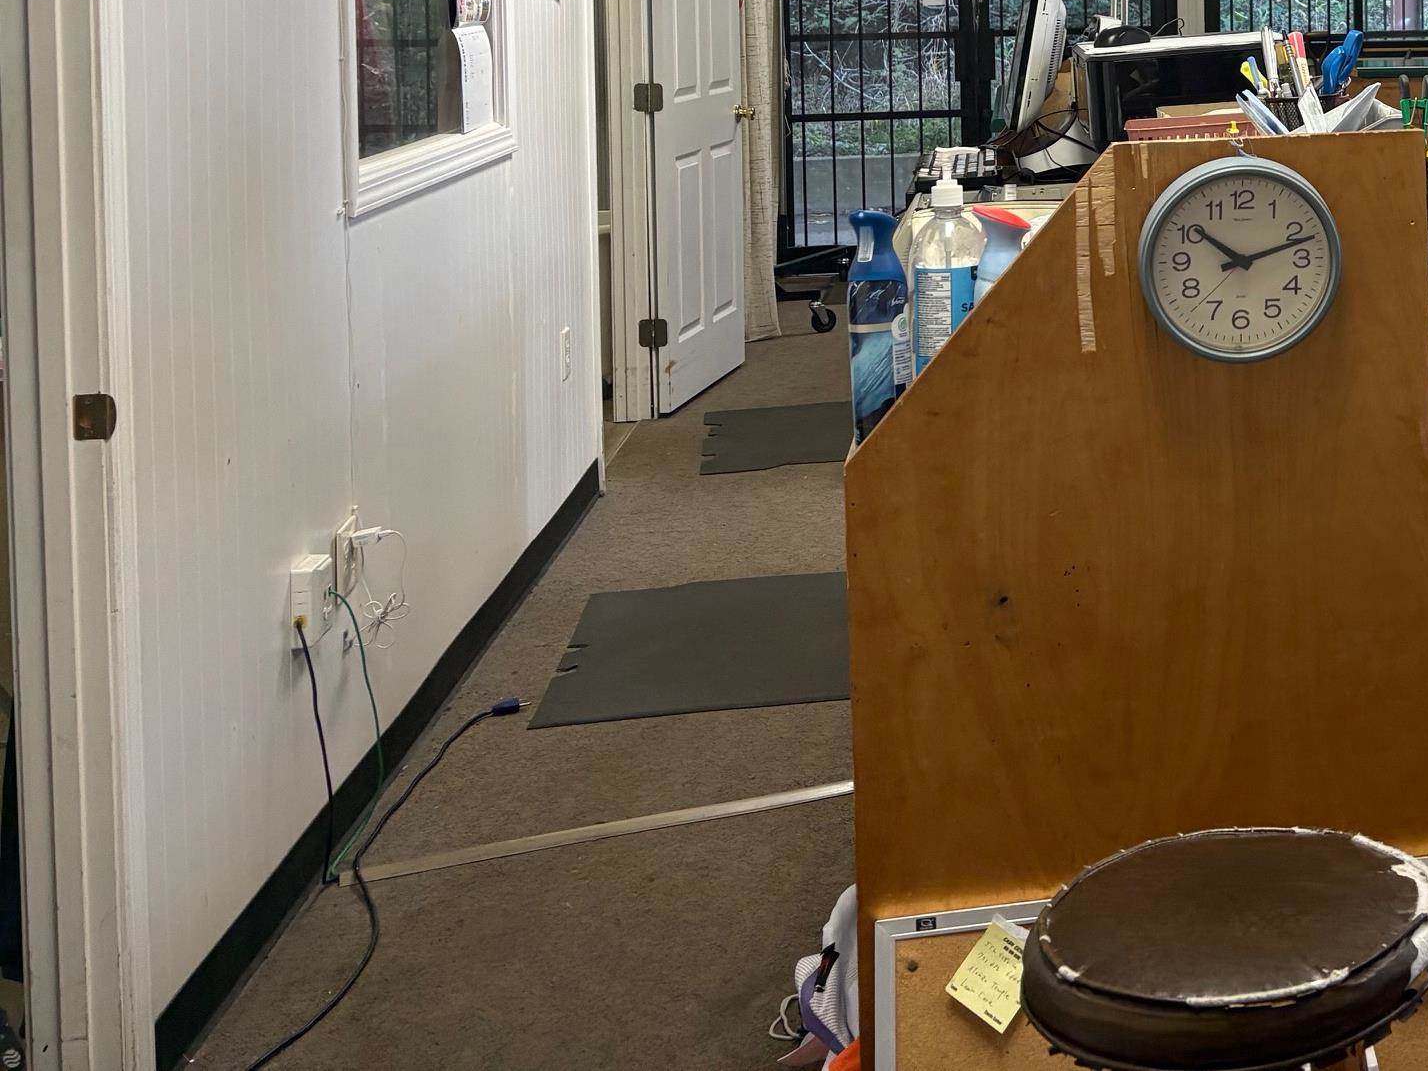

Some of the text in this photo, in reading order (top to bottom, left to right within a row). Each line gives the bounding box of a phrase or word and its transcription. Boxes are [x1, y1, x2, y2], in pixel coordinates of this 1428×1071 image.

[1230, 189, 1255, 210] 12
[1268, 199, 1276, 219] 1
[1205, 200, 1223, 221] 11
[1177, 224, 1206, 245] 10
[1286, 222, 1304, 242] 2
[1172, 251, 1192, 272] 9
[1292, 248, 1311, 269] 3
[1181, 277, 1201, 298] 8
[1282, 275, 1302, 295] 4
[1206, 300, 1224, 321] 7
[1263, 298, 1282, 319] 5
[1231, 309, 1251, 330] 6
